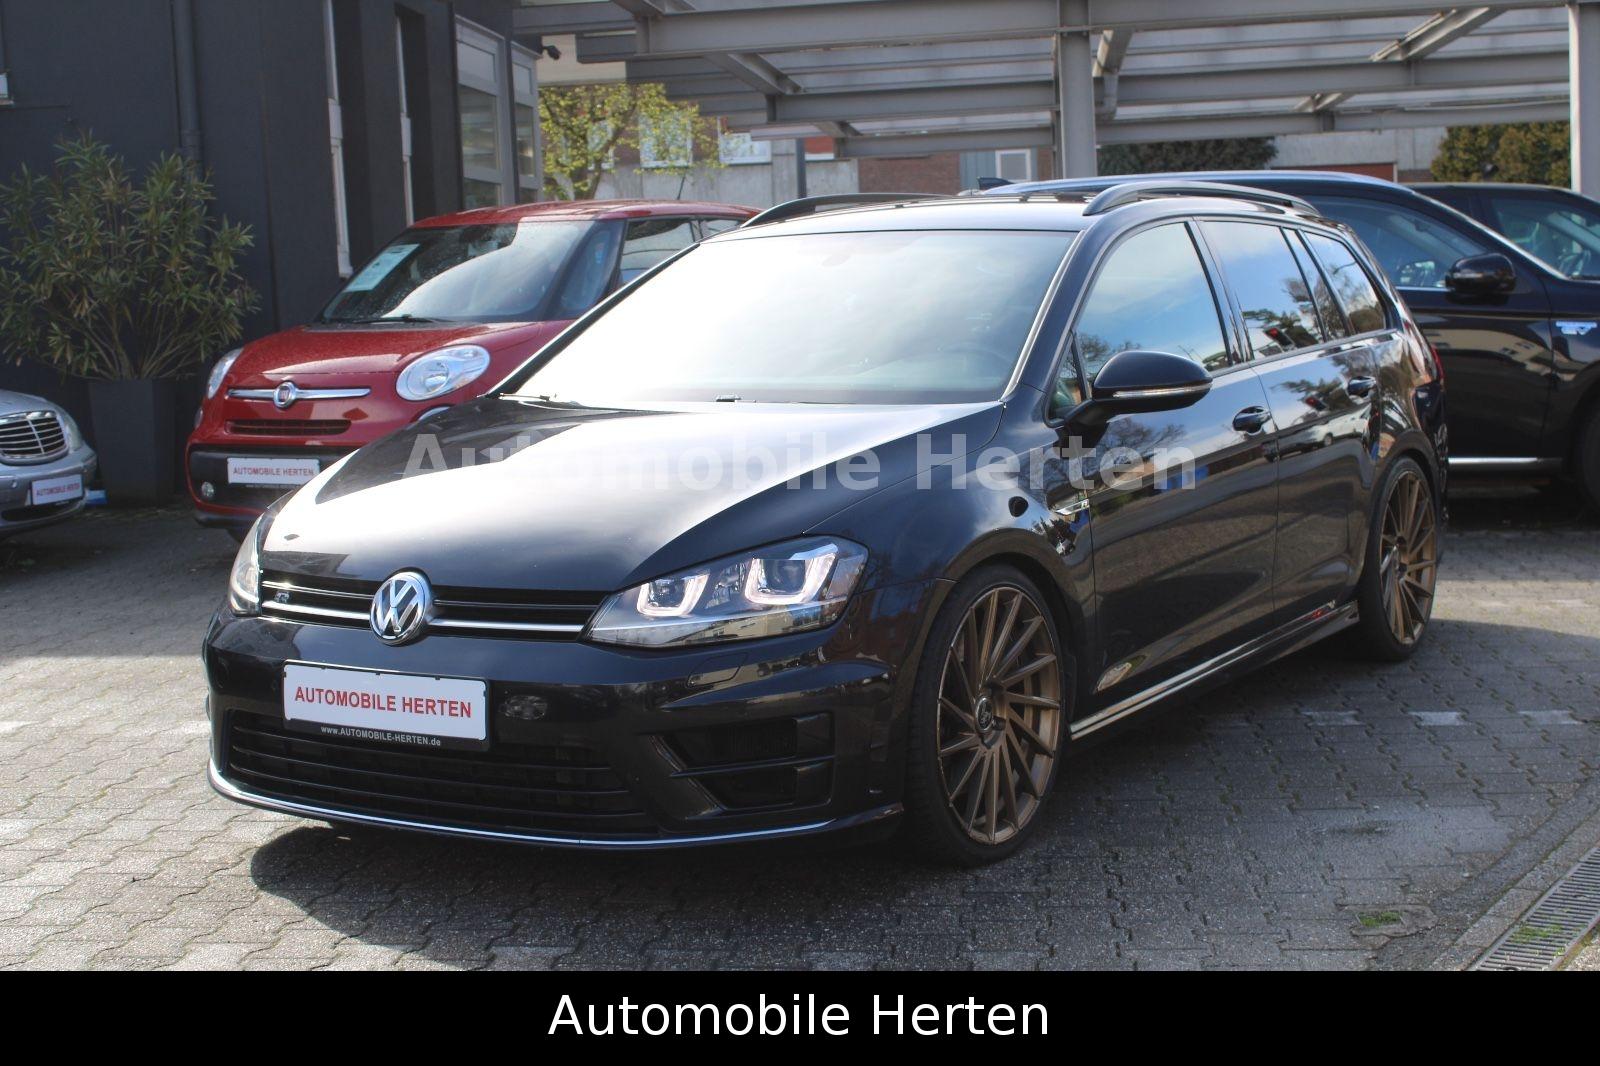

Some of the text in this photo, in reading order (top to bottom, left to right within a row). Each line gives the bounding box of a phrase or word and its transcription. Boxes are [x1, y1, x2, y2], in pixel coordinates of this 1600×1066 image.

[233, 467, 314, 477] AUTOMOBILE HERTEN
[294, 686, 472, 718] AUTOMOBILE HERTEN
[320, 725, 442, 746] www.AUTOMOBILE-HERTEN.de
